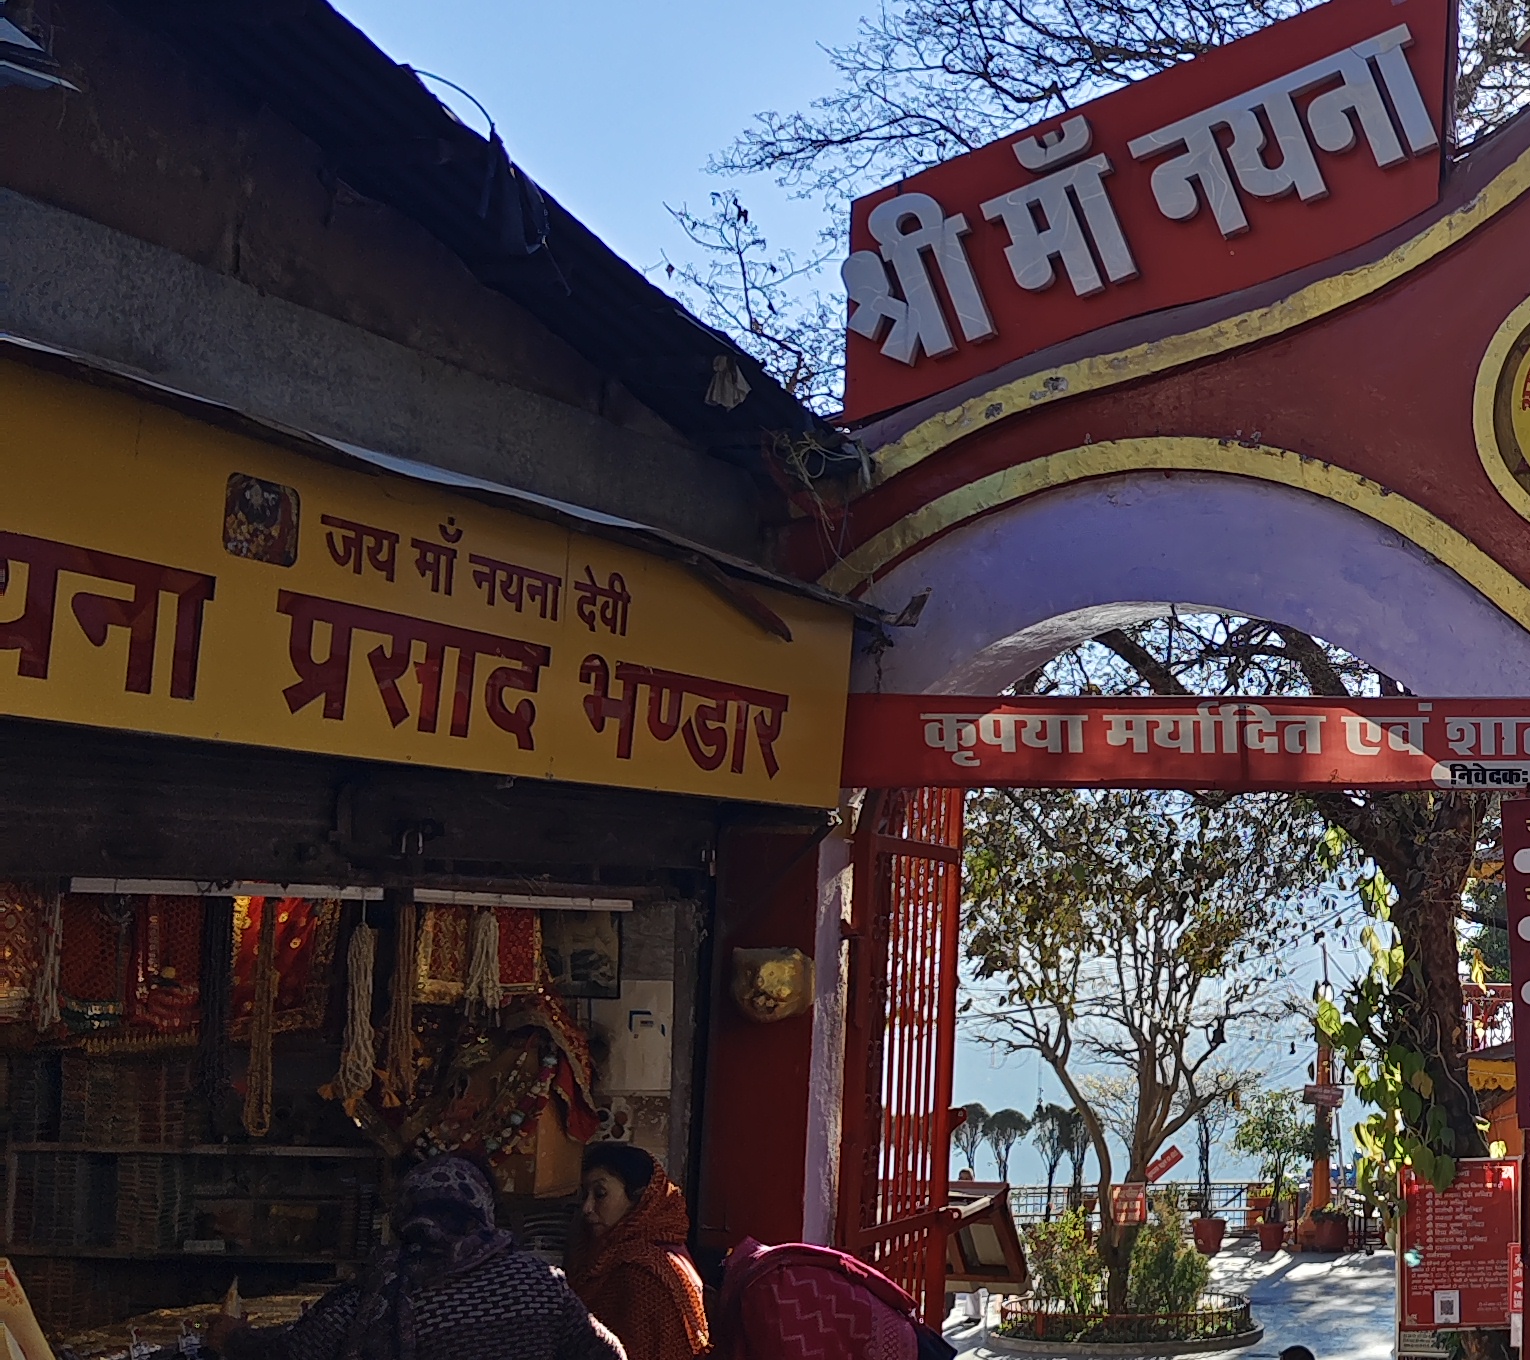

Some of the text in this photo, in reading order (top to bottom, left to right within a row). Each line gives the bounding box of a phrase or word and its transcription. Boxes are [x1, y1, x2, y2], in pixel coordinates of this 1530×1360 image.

[840, 192, 997, 367] श्री
[1128, 24, 1440, 240] नयना
[321, 514, 632, 637] जय माँ नयना देवी
[277, 588, 551, 751] प्रसाद
[579, 652, 790, 780] भण्डार
[920, 712, 1088, 767] कृपया
[1103, 701, 1327, 756] मर्यादित
[1340, 703, 1431, 757] एवं
